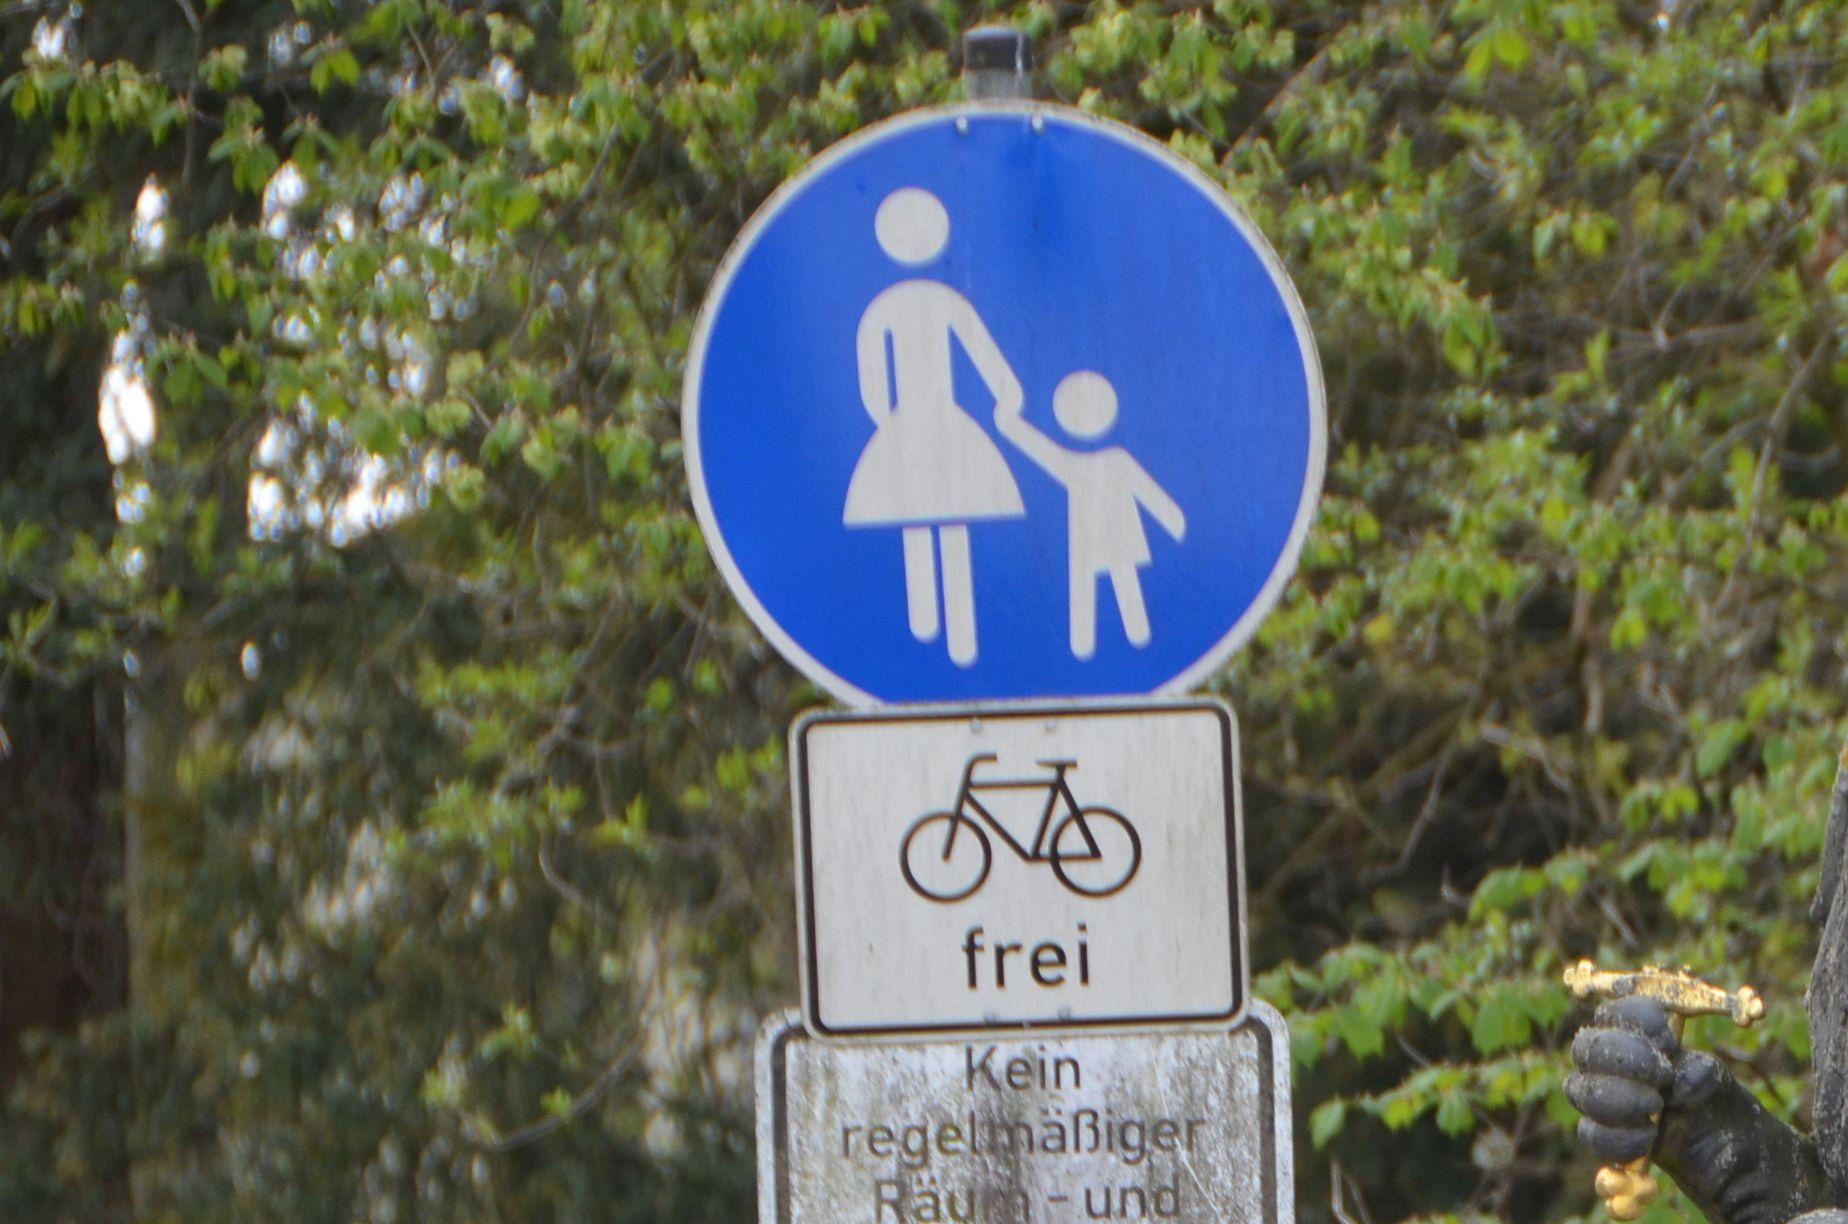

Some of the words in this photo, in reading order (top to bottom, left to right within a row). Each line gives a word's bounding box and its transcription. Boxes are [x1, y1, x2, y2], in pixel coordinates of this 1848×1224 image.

[962, 923, 1091, 991] frei
[964, 1045, 1081, 1092] Kein
[842, 1109, 1206, 1168] regelmäßiger
[1085, 1175, 1181, 1220] und
